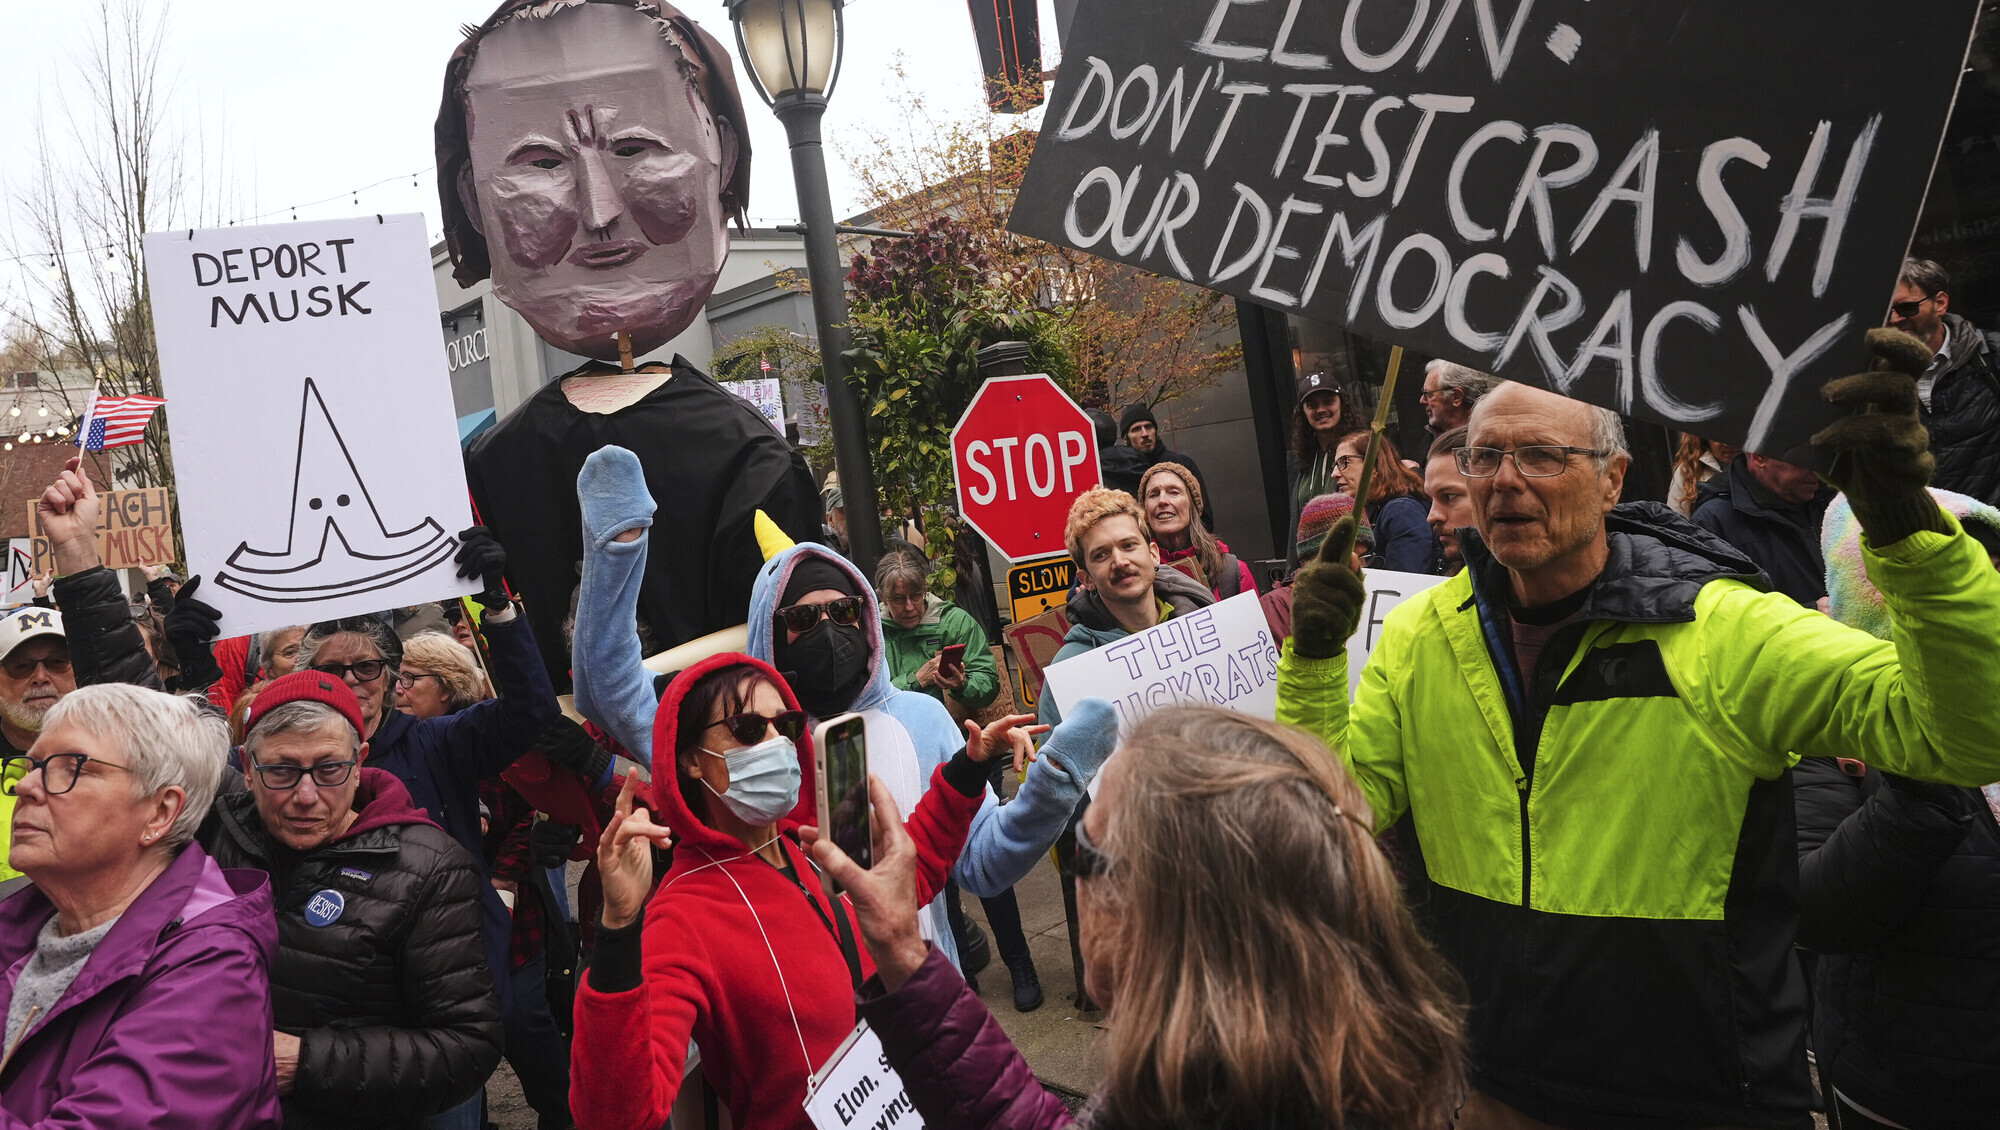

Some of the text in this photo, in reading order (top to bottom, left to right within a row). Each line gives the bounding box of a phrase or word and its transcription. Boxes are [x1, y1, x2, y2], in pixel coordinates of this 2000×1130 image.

[1053, 56, 1883, 298] DON'T TEST CRASH
[192, 238, 355, 287] DEPORT
[210, 281, 372, 328] MUSK
[1064, 165, 1854, 453] OUR DEMOCRACY
[966, 430, 1087, 505] STOP
[105, 526, 173, 567] MUSK
[1018, 565, 1069, 594] SLOW
[18, 611, 53, 633] M
[1105, 608, 1221, 680] THE
[308, 895, 340, 921] RESIST
[833, 1074, 880, 1127] Elon,
